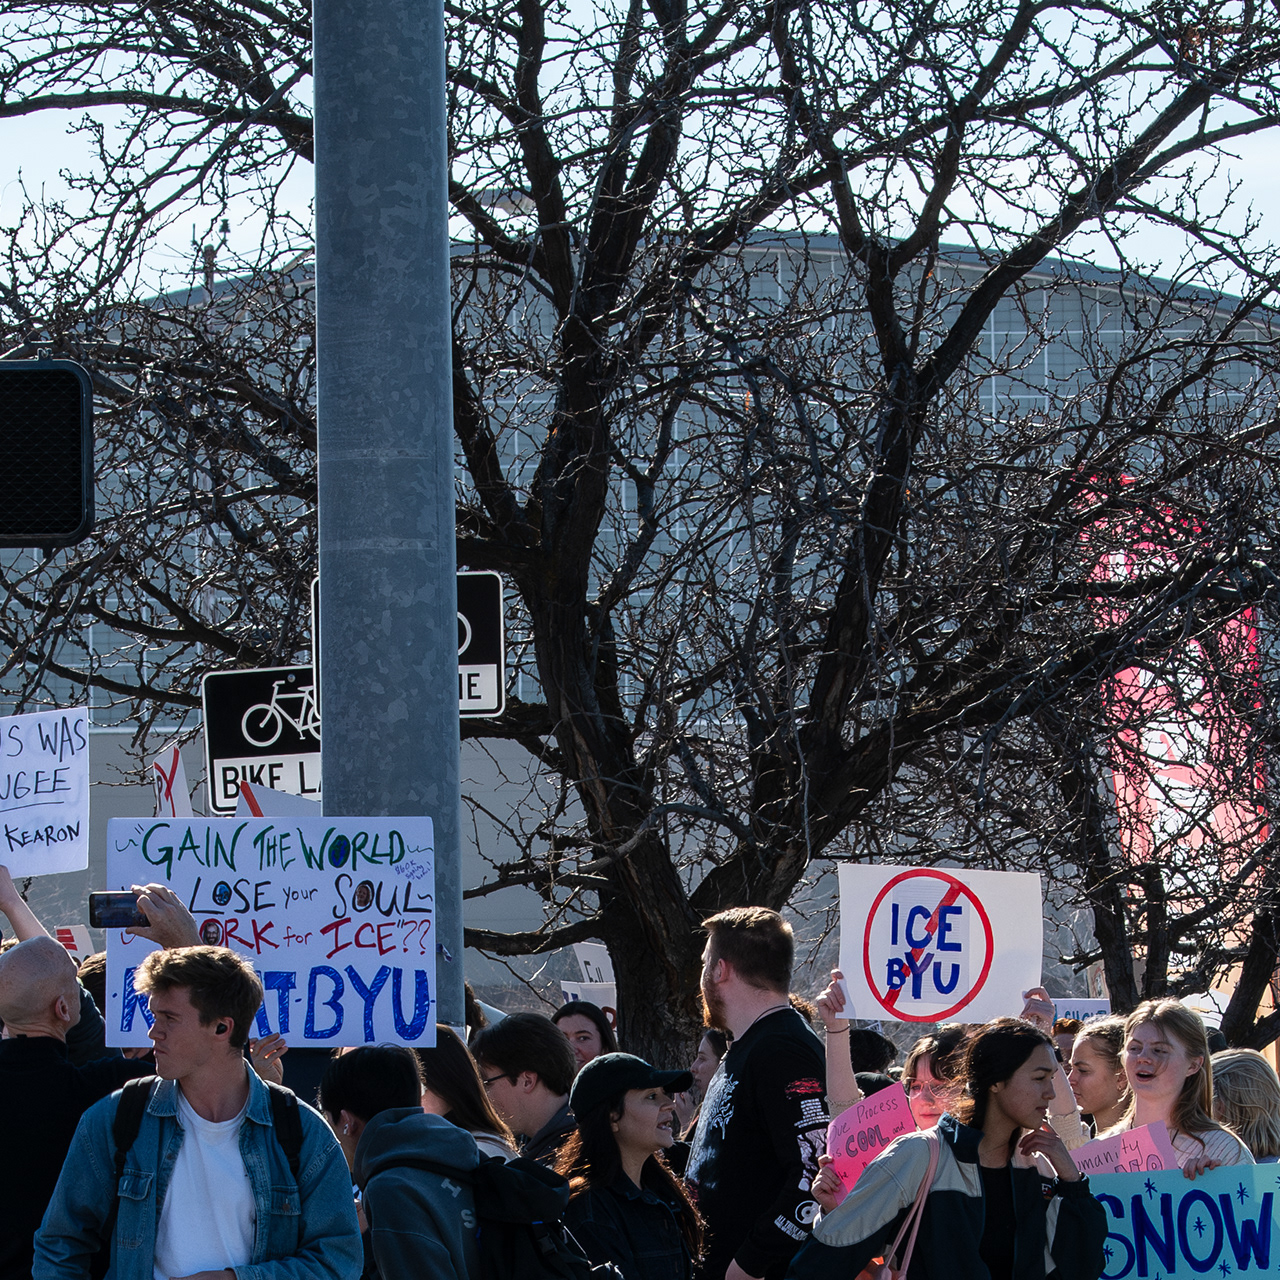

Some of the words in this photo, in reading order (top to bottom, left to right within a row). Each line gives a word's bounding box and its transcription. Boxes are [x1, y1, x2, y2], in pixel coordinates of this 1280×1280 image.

[38, 716, 86, 762] WAS
[5, 821, 81, 852] KEARON
[253, 825, 296, 871] THE
[297, 827, 406, 871] WORLD
[190, 876, 276, 914] LOSE
[283, 886, 319, 909] your
[333, 873, 432, 919] SOUL
[199, 917, 280, 955] ORK
[283, 925, 314, 947] for
[891, 902, 963, 953] ICE
[886, 951, 961, 1000] BYU
[857, 1098, 899, 1125] Process
[846, 1124, 891, 1158] COOL
[1095, 1188, 1274, 1280] SNOW
